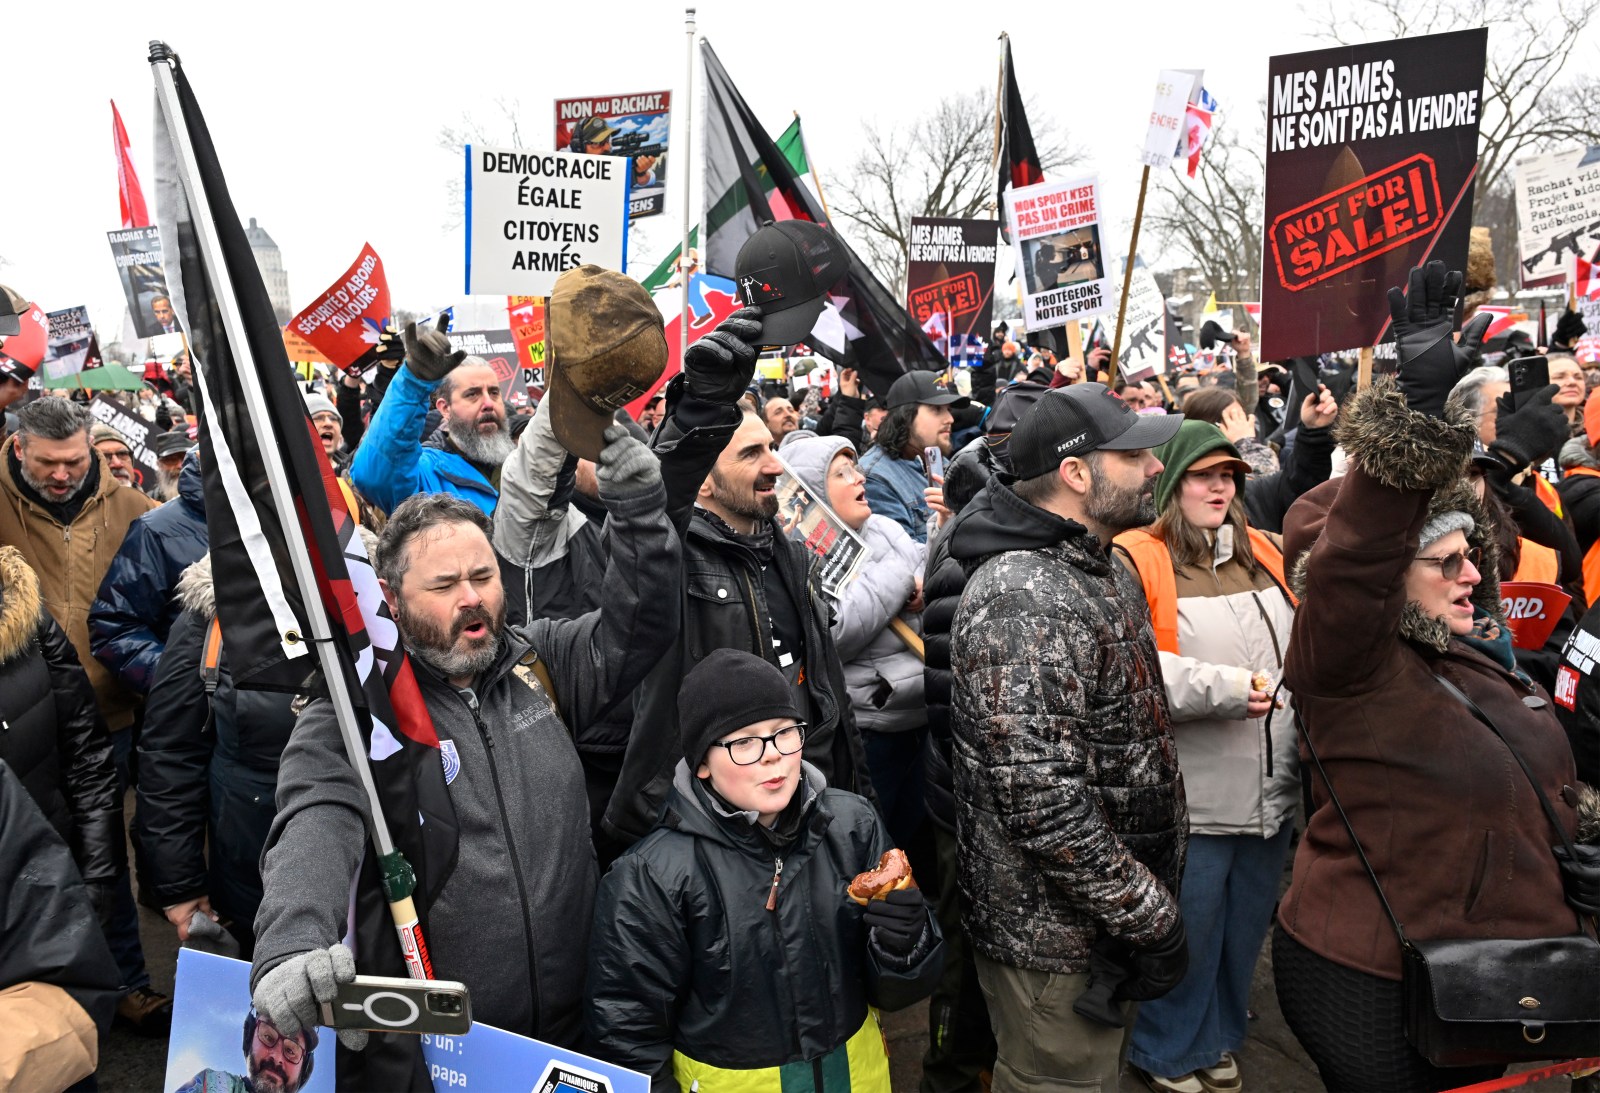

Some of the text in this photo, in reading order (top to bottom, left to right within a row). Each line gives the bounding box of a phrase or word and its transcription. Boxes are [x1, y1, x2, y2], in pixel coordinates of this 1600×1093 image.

[1272, 59, 1396, 116] MES ARMES
[561, 94, 665, 120] NON AU RACHAT.
[1271, 88, 1479, 153] NE SONT PAS À VENDRE
[483, 151, 612, 180] DEMOCRACIE
[518, 176, 582, 209] ÉGALE
[1014, 185, 1094, 213] MON SPORT N'EST
[1527, 177, 1573, 196] Rachat
[629, 197, 654, 214] SENS
[1017, 198, 1096, 227] PAS UN CRIME
[1284, 175, 1406, 245] NOT FOR
[1529, 191, 1569, 209] Projet
[503, 220, 600, 244] CITOYENS
[911, 224, 931, 245] MES
[1058, 216, 1078, 230] NOTRE
[1079, 213, 1098, 224] SPORT
[1290, 166, 1429, 277] SALE!
[108, 230, 144, 244] RACHAT
[512, 243, 582, 272] ARMÉS
[910, 244, 921, 261] NE
[921, 245, 943, 262] SONT
[943, 245, 960, 262] PAS
[966, 246, 996, 263] VENDRE
[914, 280, 966, 306] NOT FOR
[1035, 283, 1101, 309] PROTÉGEONS
[297, 292, 344, 335] SÉCURITÉ
[325, 284, 379, 333] TOUJOURS.
[1035, 295, 1103, 321] NOTRE SPORT
[1057, 432, 1087, 453] HOYT
[435, 1034, 454, 1053] un
[431, 1063, 467, 1088] papa
[559, 1071, 599, 1093] DYNAMIQUES
